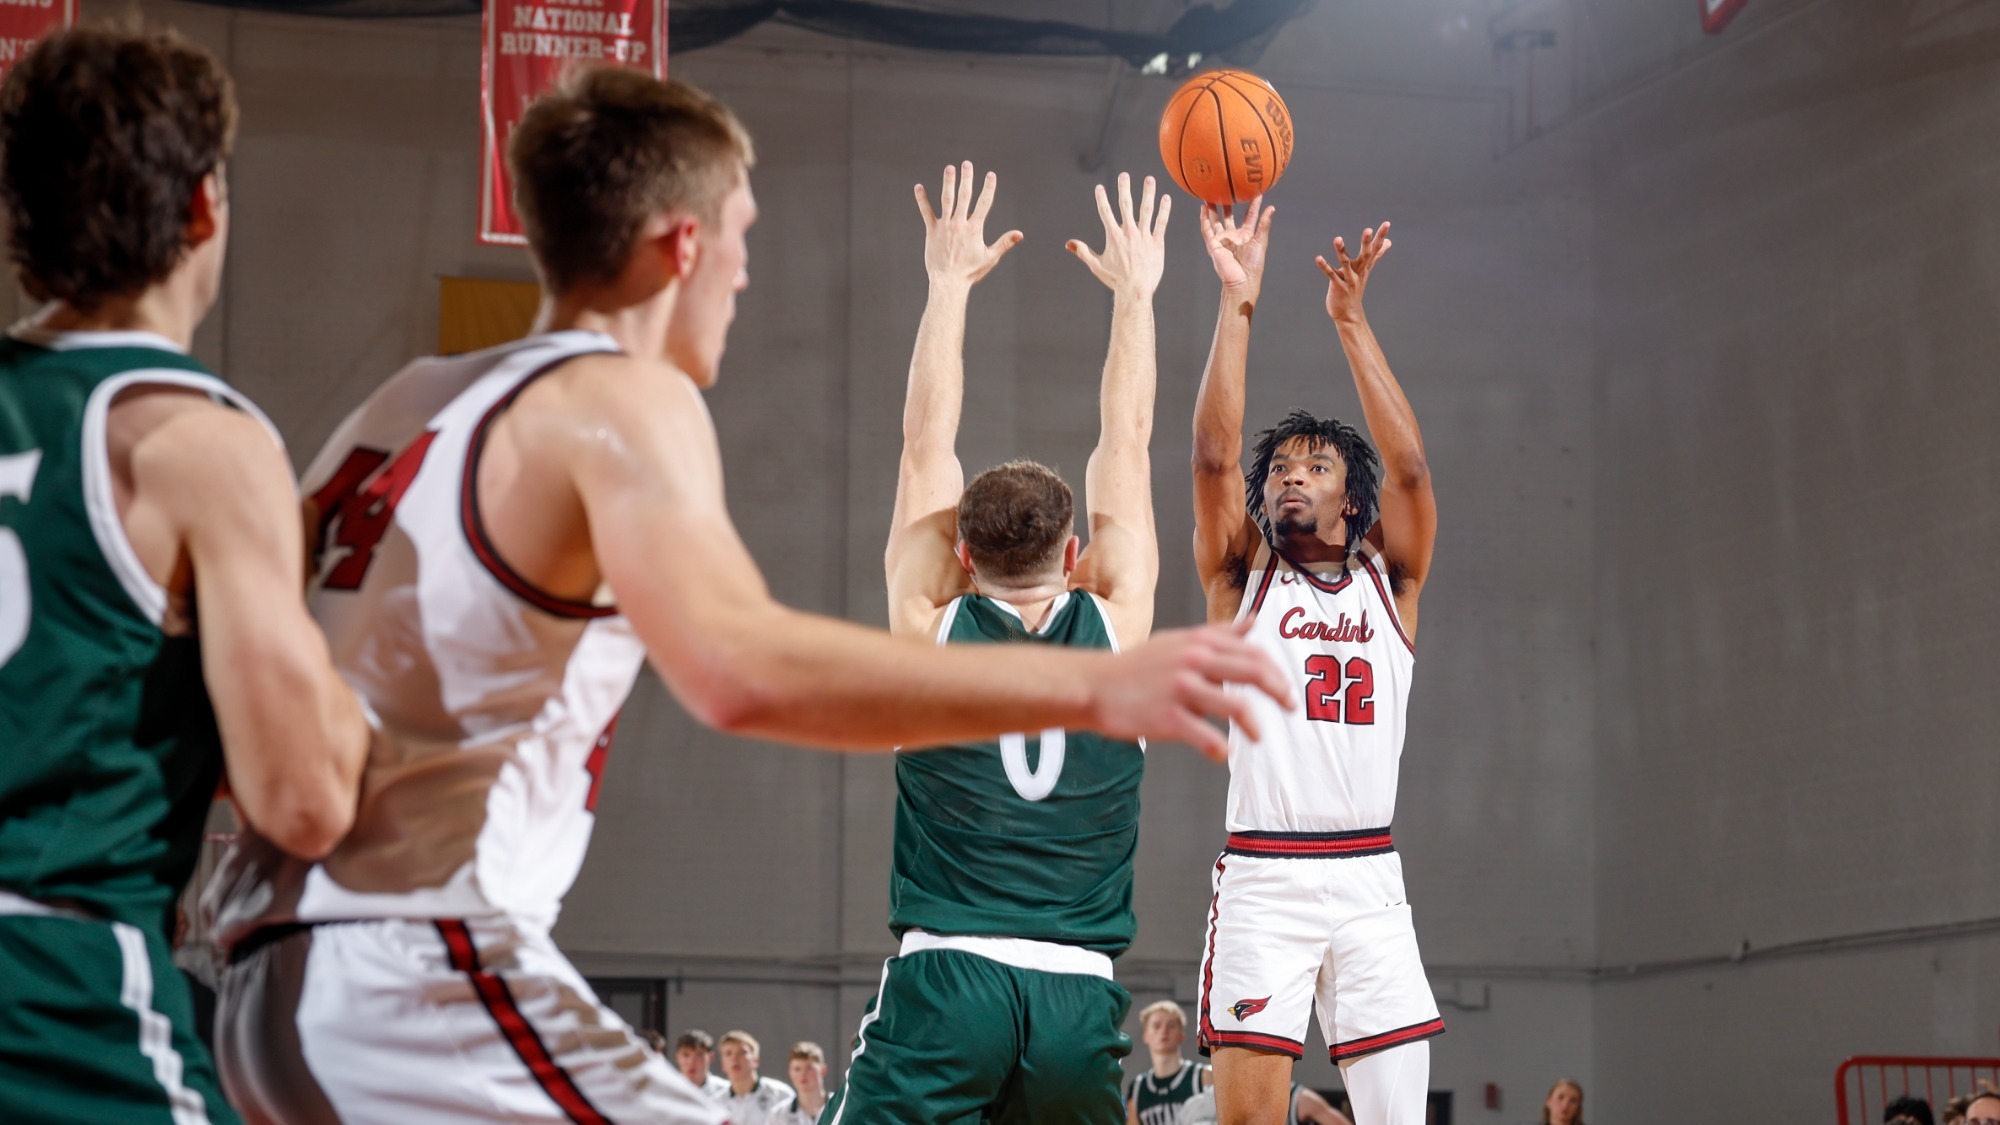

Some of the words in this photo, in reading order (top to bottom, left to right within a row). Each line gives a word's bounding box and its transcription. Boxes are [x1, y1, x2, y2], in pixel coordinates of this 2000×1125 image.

[512, 6, 634, 36] NATIONAL
[500, 32, 646, 63] RUNNER-UP
[1240, 138, 1263, 183] EVO
[1304, 653, 1375, 725] 22
